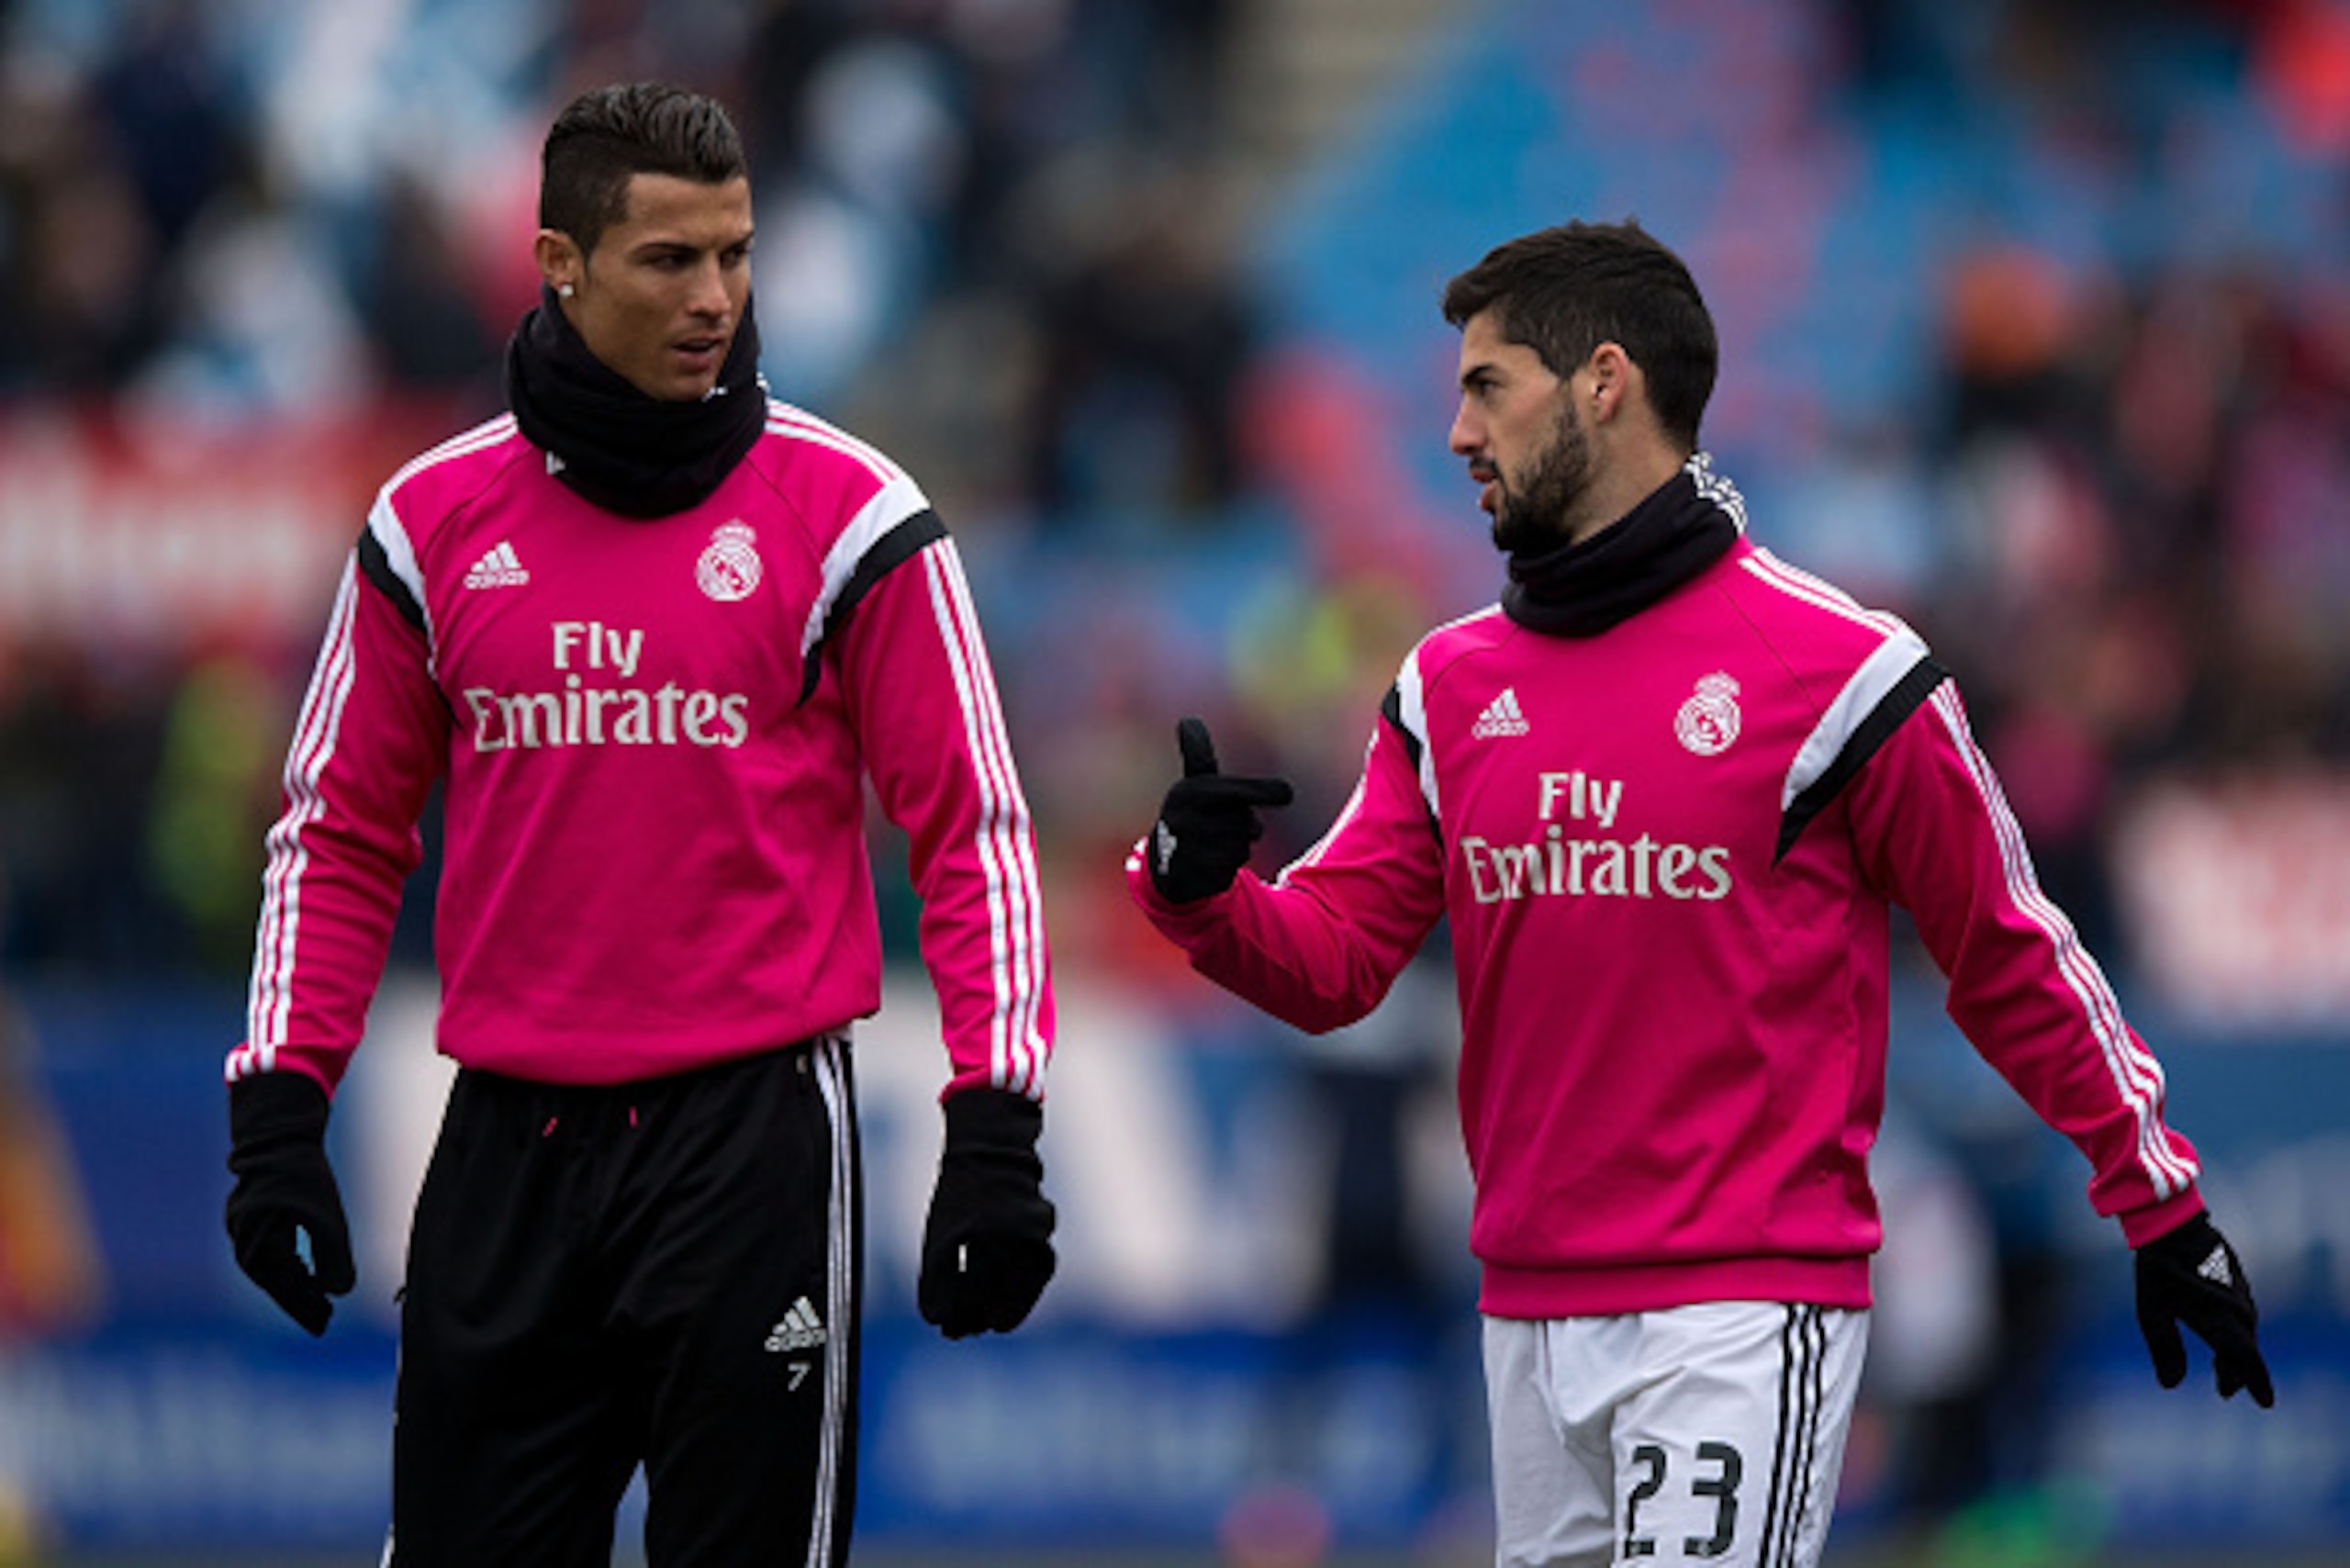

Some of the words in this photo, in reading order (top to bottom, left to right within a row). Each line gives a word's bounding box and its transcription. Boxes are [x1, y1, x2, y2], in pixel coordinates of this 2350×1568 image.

[552, 621, 643, 677] Fly
[464, 673, 749, 752] Emirates
[1539, 770, 1623, 828] Fly
[1460, 824, 1733, 903] Emirates
[788, 1362, 811, 1392] 7
[1624, 1440, 1742, 1559] 23
